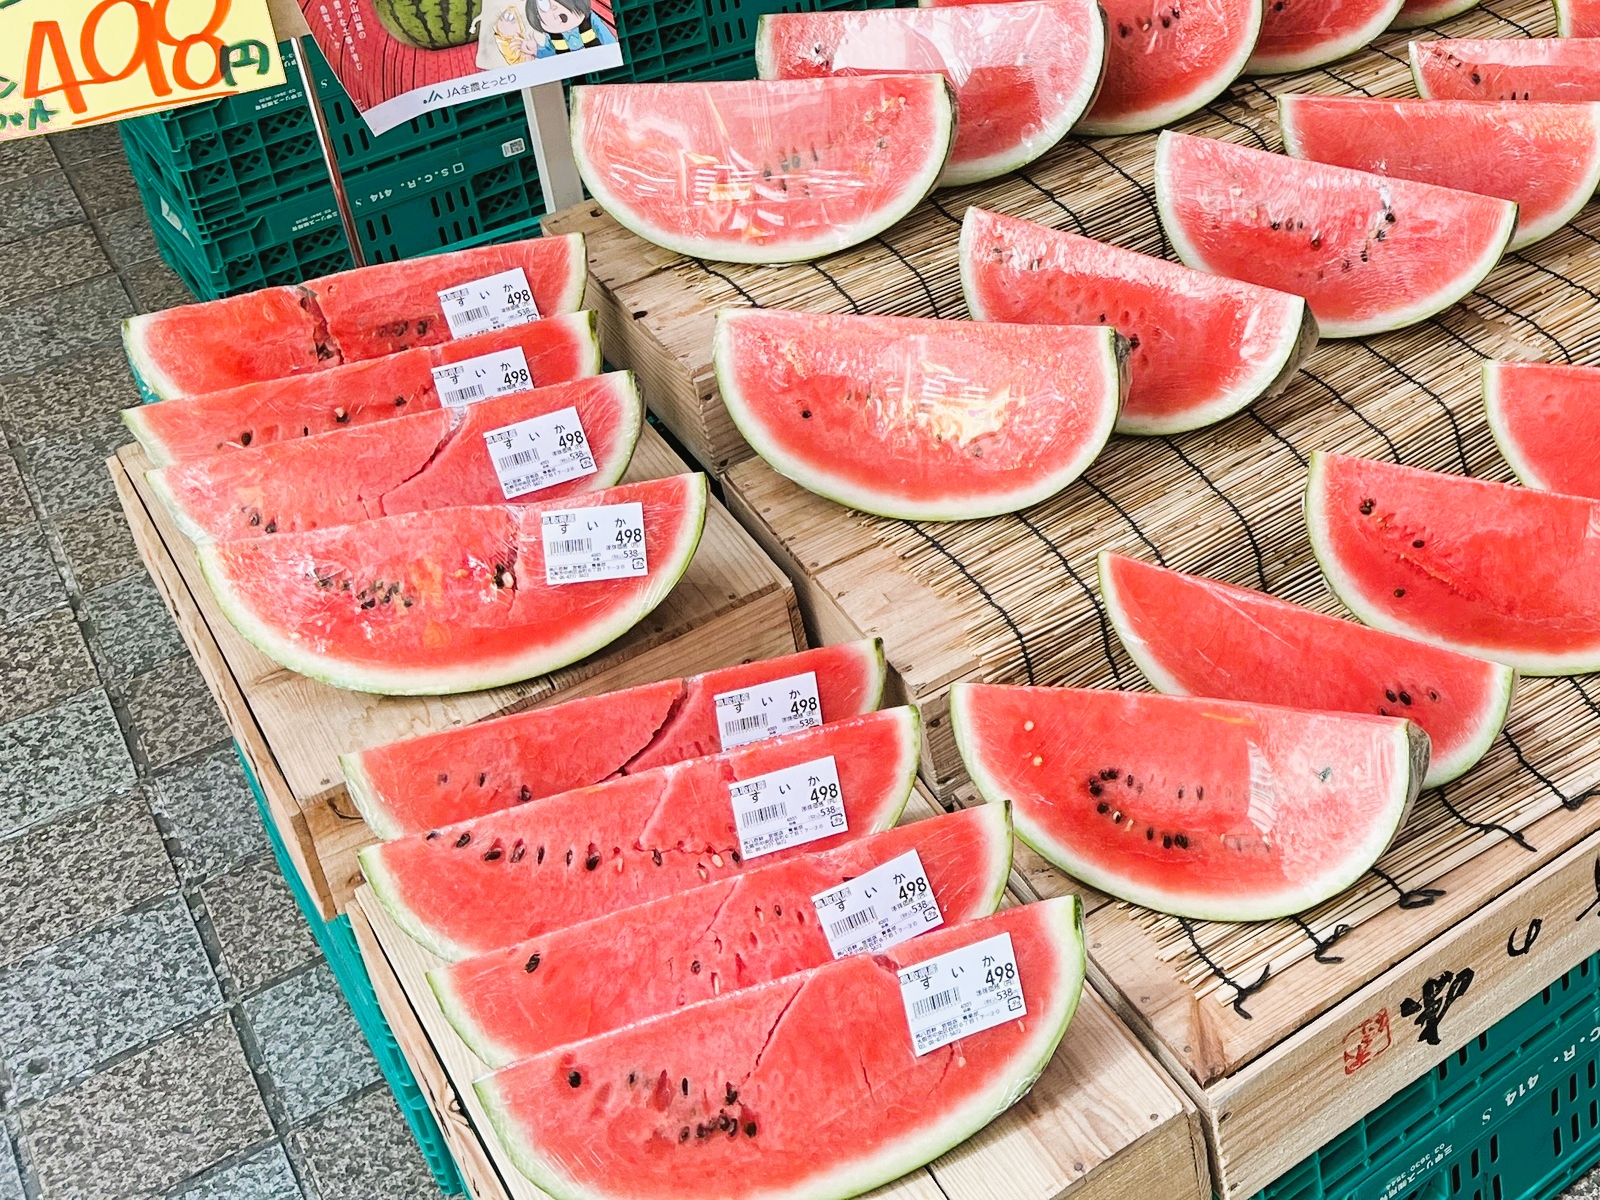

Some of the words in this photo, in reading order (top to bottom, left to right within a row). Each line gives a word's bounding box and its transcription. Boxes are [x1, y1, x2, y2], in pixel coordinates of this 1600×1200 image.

[369, 188, 393, 203] 414
[507, 288, 531, 307] 498
[504, 367, 529, 387] 498
[558, 430, 584, 449] 498
[615, 527, 643, 545] 498
[789, 696, 818, 715] 498
[810, 782, 839, 804] 498
[898, 876, 928, 903] 498
[985, 962, 1015, 987] 498
[1504, 1072, 1541, 1106] 414
